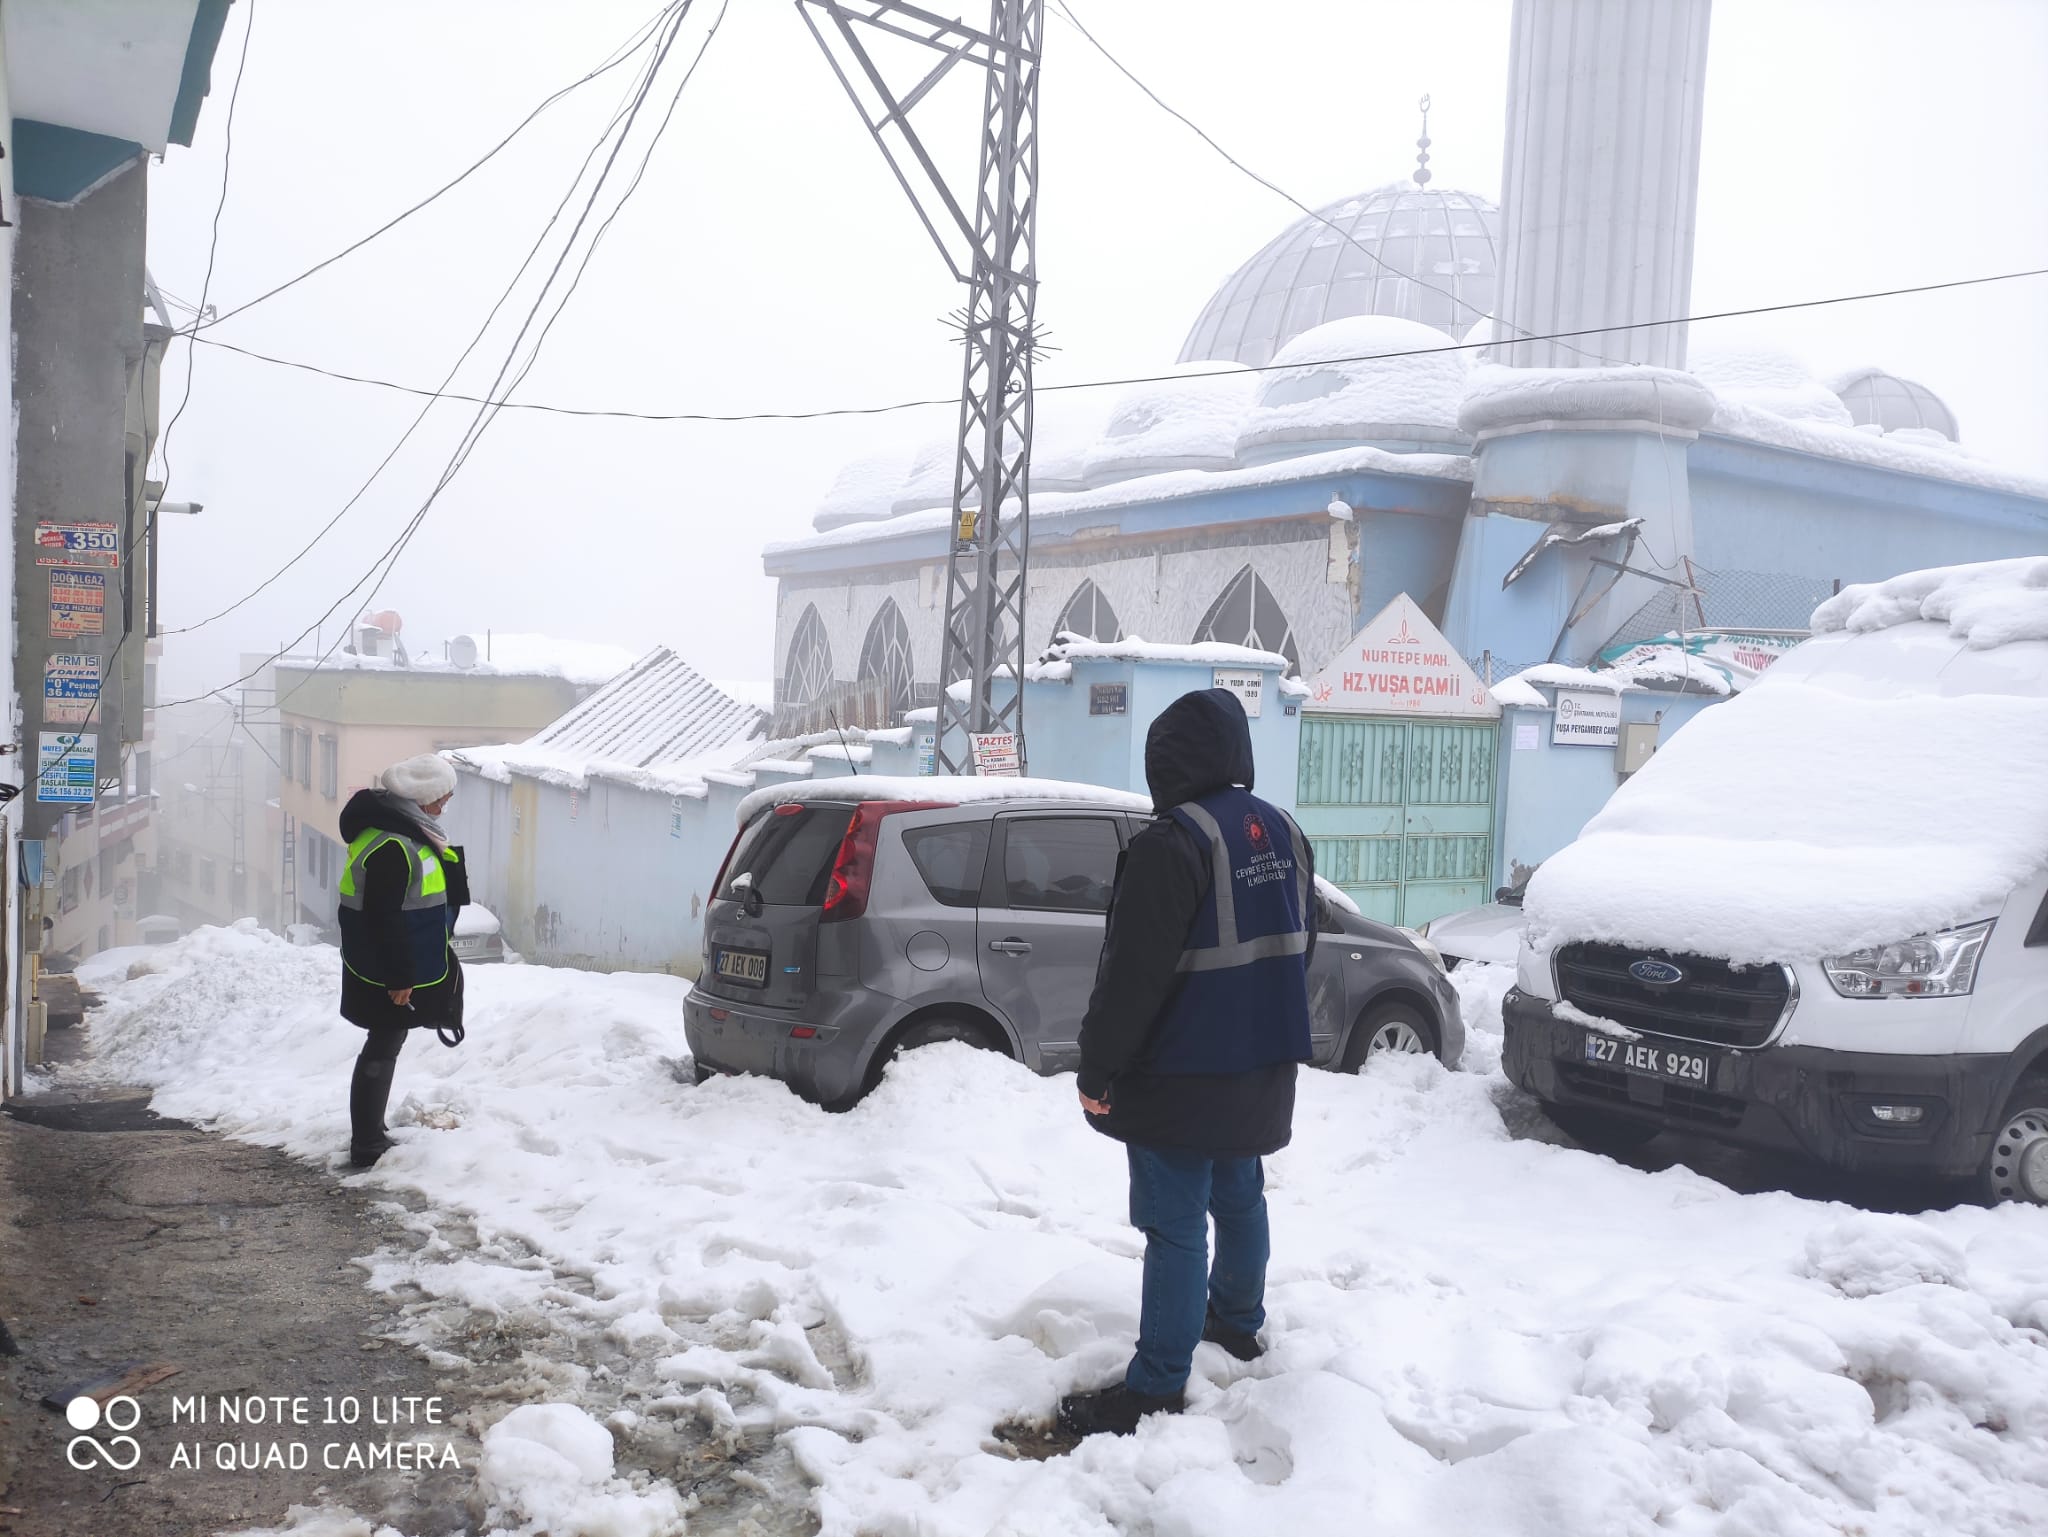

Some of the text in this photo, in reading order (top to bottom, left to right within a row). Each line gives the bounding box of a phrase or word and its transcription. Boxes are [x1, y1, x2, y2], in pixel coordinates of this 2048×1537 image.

[73, 532, 115, 550] 350
[52, 572, 104, 585] DOĞALGAZ
[57, 656, 81, 666] FRM
[1362, 649, 1451, 667] NURTEPE MAH.
[1343, 672, 1410, 697] HZ.YUŞA
[47, 688, 63, 697] 36
[1556, 724, 1570, 735] YUŞA
[1571, 724, 1603, 735] PEYGAMBER
[977, 735, 1013, 746] GAZTES
[40, 787, 57, 795] 0554
[83, 788, 92, 796] 27
[720, 953, 730, 972] 27
[748, 958, 764, 978] 008
[1637, 963, 1668, 980] Ford
[1595, 1038, 1618, 1061] 27
[1625, 1045, 1658, 1070] AEK
[1666, 1053, 1703, 1080] 929
